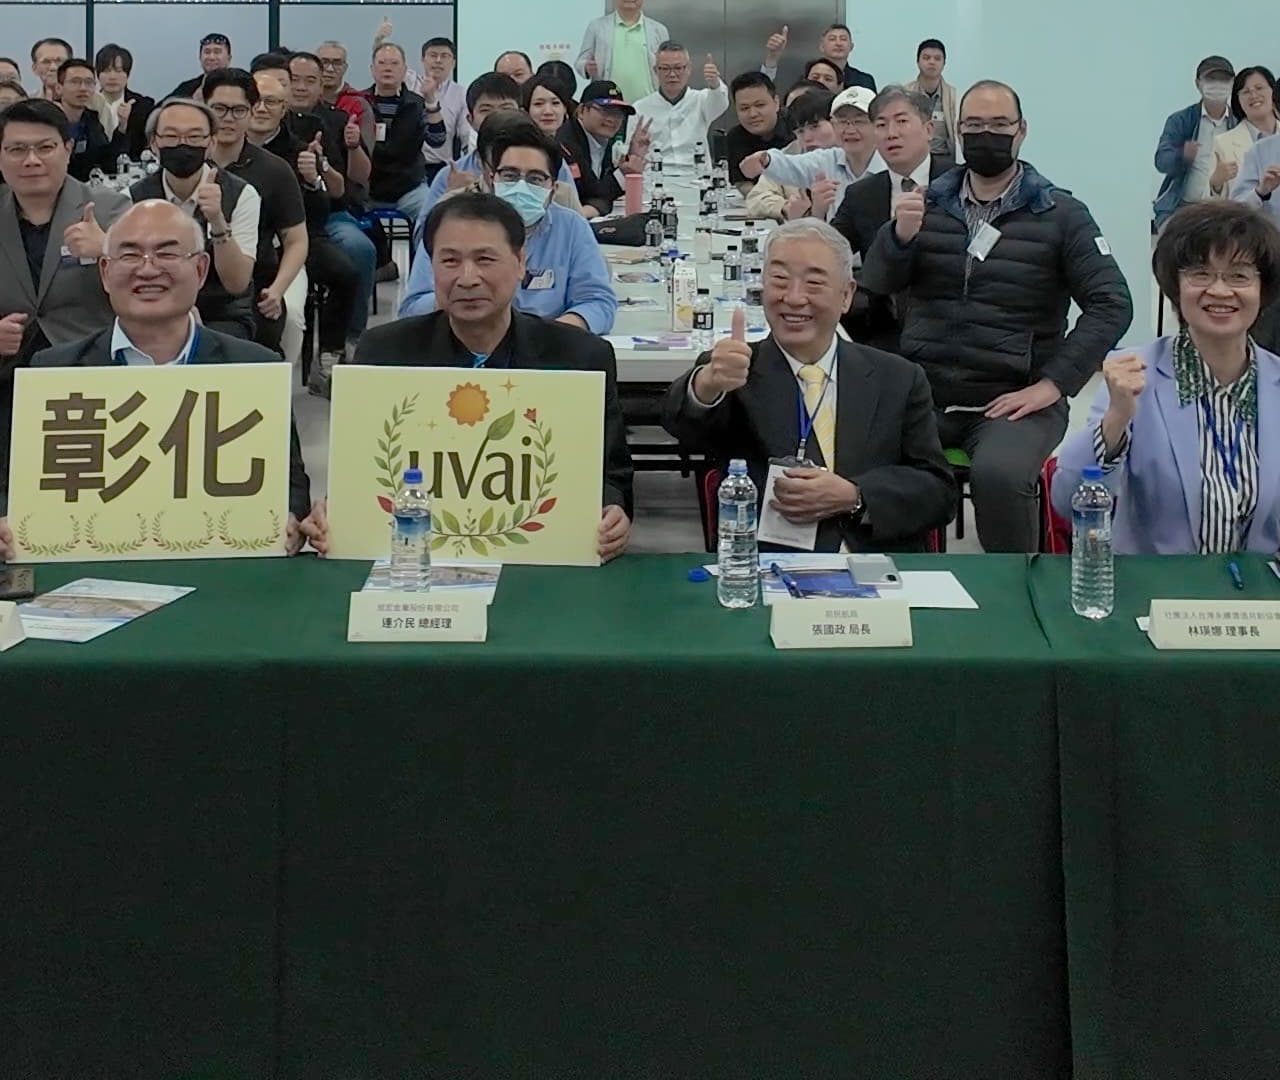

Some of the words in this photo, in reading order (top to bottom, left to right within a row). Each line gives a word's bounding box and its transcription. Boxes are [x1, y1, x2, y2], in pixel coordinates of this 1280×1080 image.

[39, 389, 266, 504] 彰化
[409, 434, 533, 505] uvai
[382, 617, 415, 629] 連介民
[418, 617, 452, 629] 總經理
[812, 624, 846, 636] 張國政
[848, 624, 871, 636] 局長
[1225, 626, 1261, 638] 理事長
